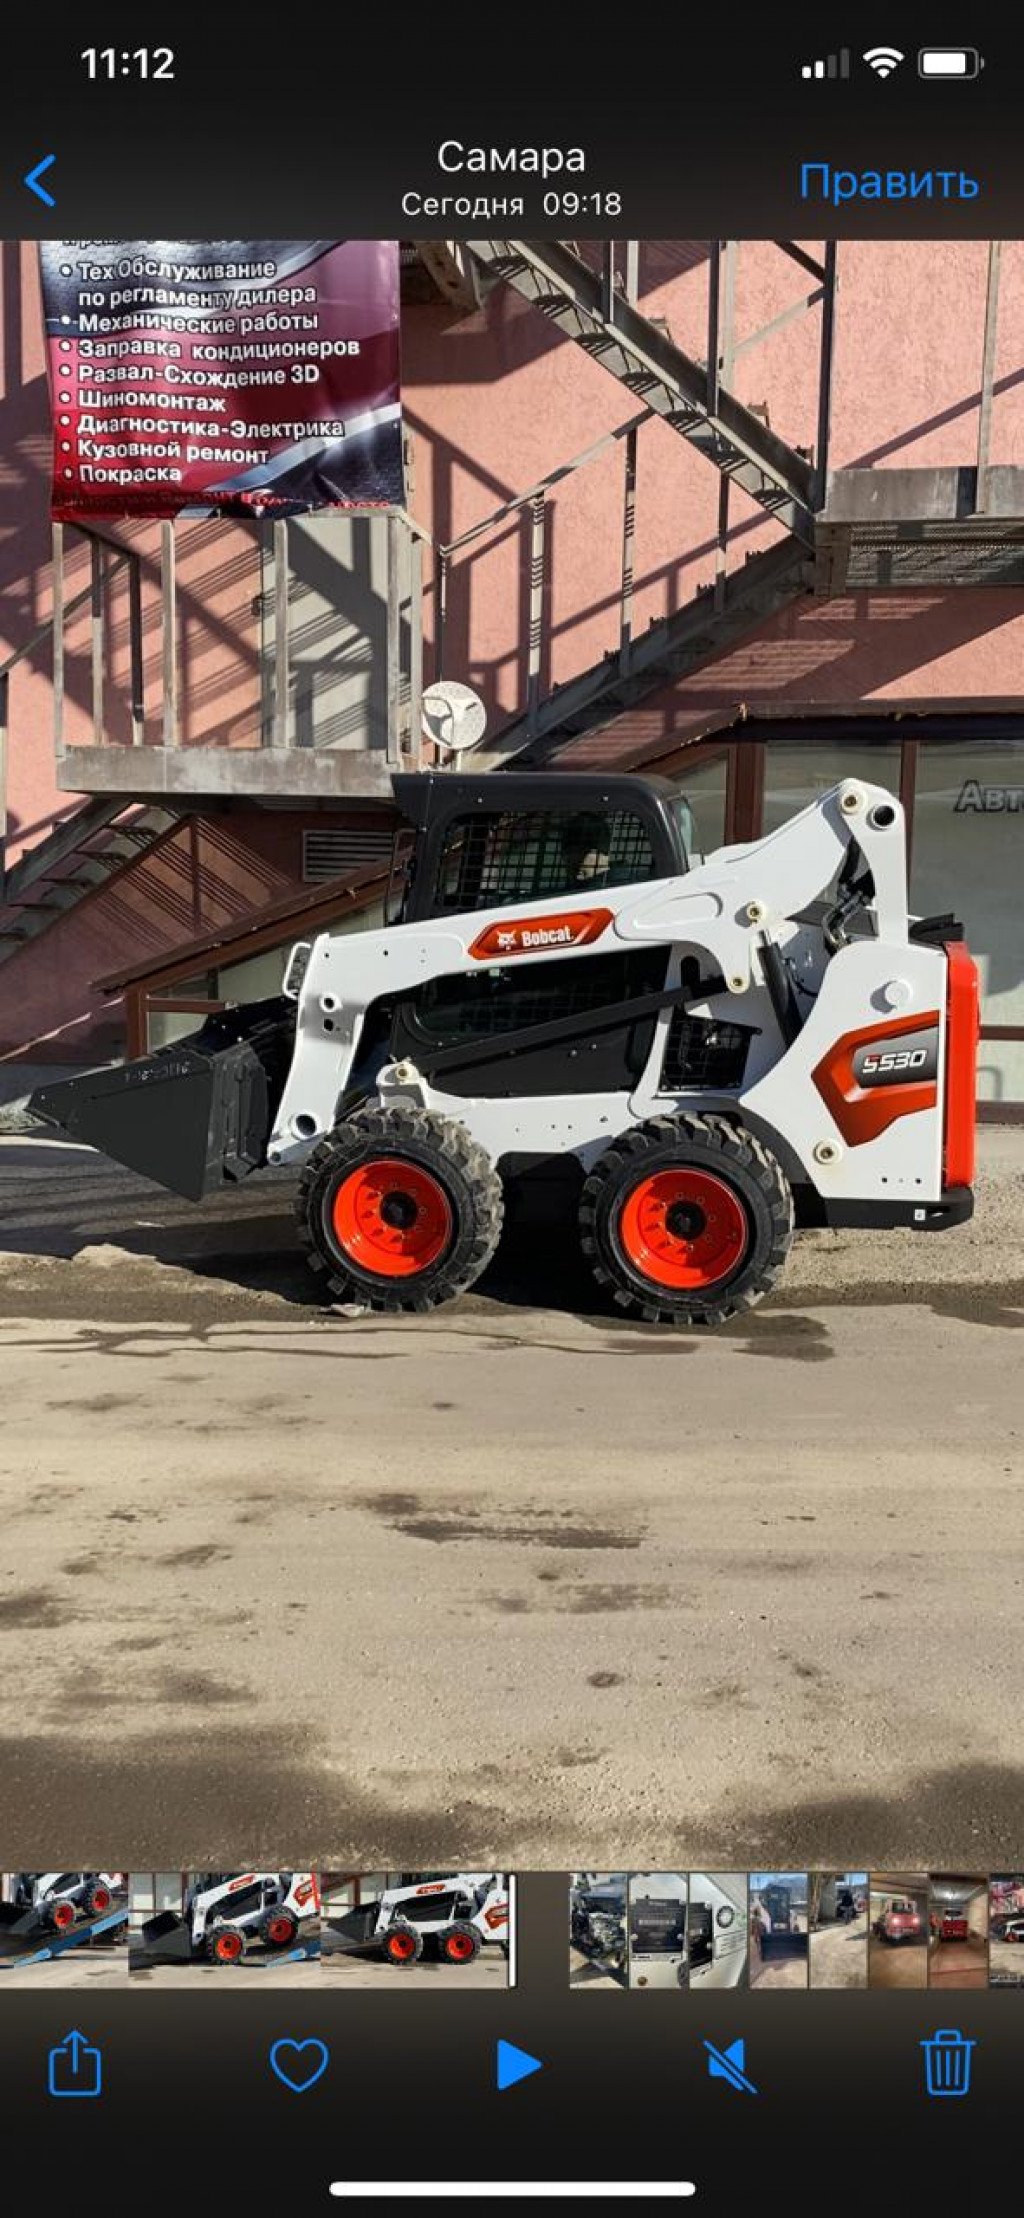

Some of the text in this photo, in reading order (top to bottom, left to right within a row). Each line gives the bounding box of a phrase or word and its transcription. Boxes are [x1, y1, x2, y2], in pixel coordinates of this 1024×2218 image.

[78, 257, 276, 283] Тех Обслуживание
[79, 291, 105, 308] по
[240, 286, 317, 306] дилера
[78, 311, 318, 336] Механические работы
[78, 339, 361, 361] Заправка кондиционеров
[78, 364, 320, 388] Развал-Схождение 3D
[78, 389, 226, 413] Шиномонтаж
[77, 414, 345, 440] Диагностика-Электрика
[78, 439, 269, 466] Кузовной ремонт
[78, 464, 182, 485] Покраска
[520, 924, 572, 948] Bobcat
[862, 1049, 928, 1074] S530
